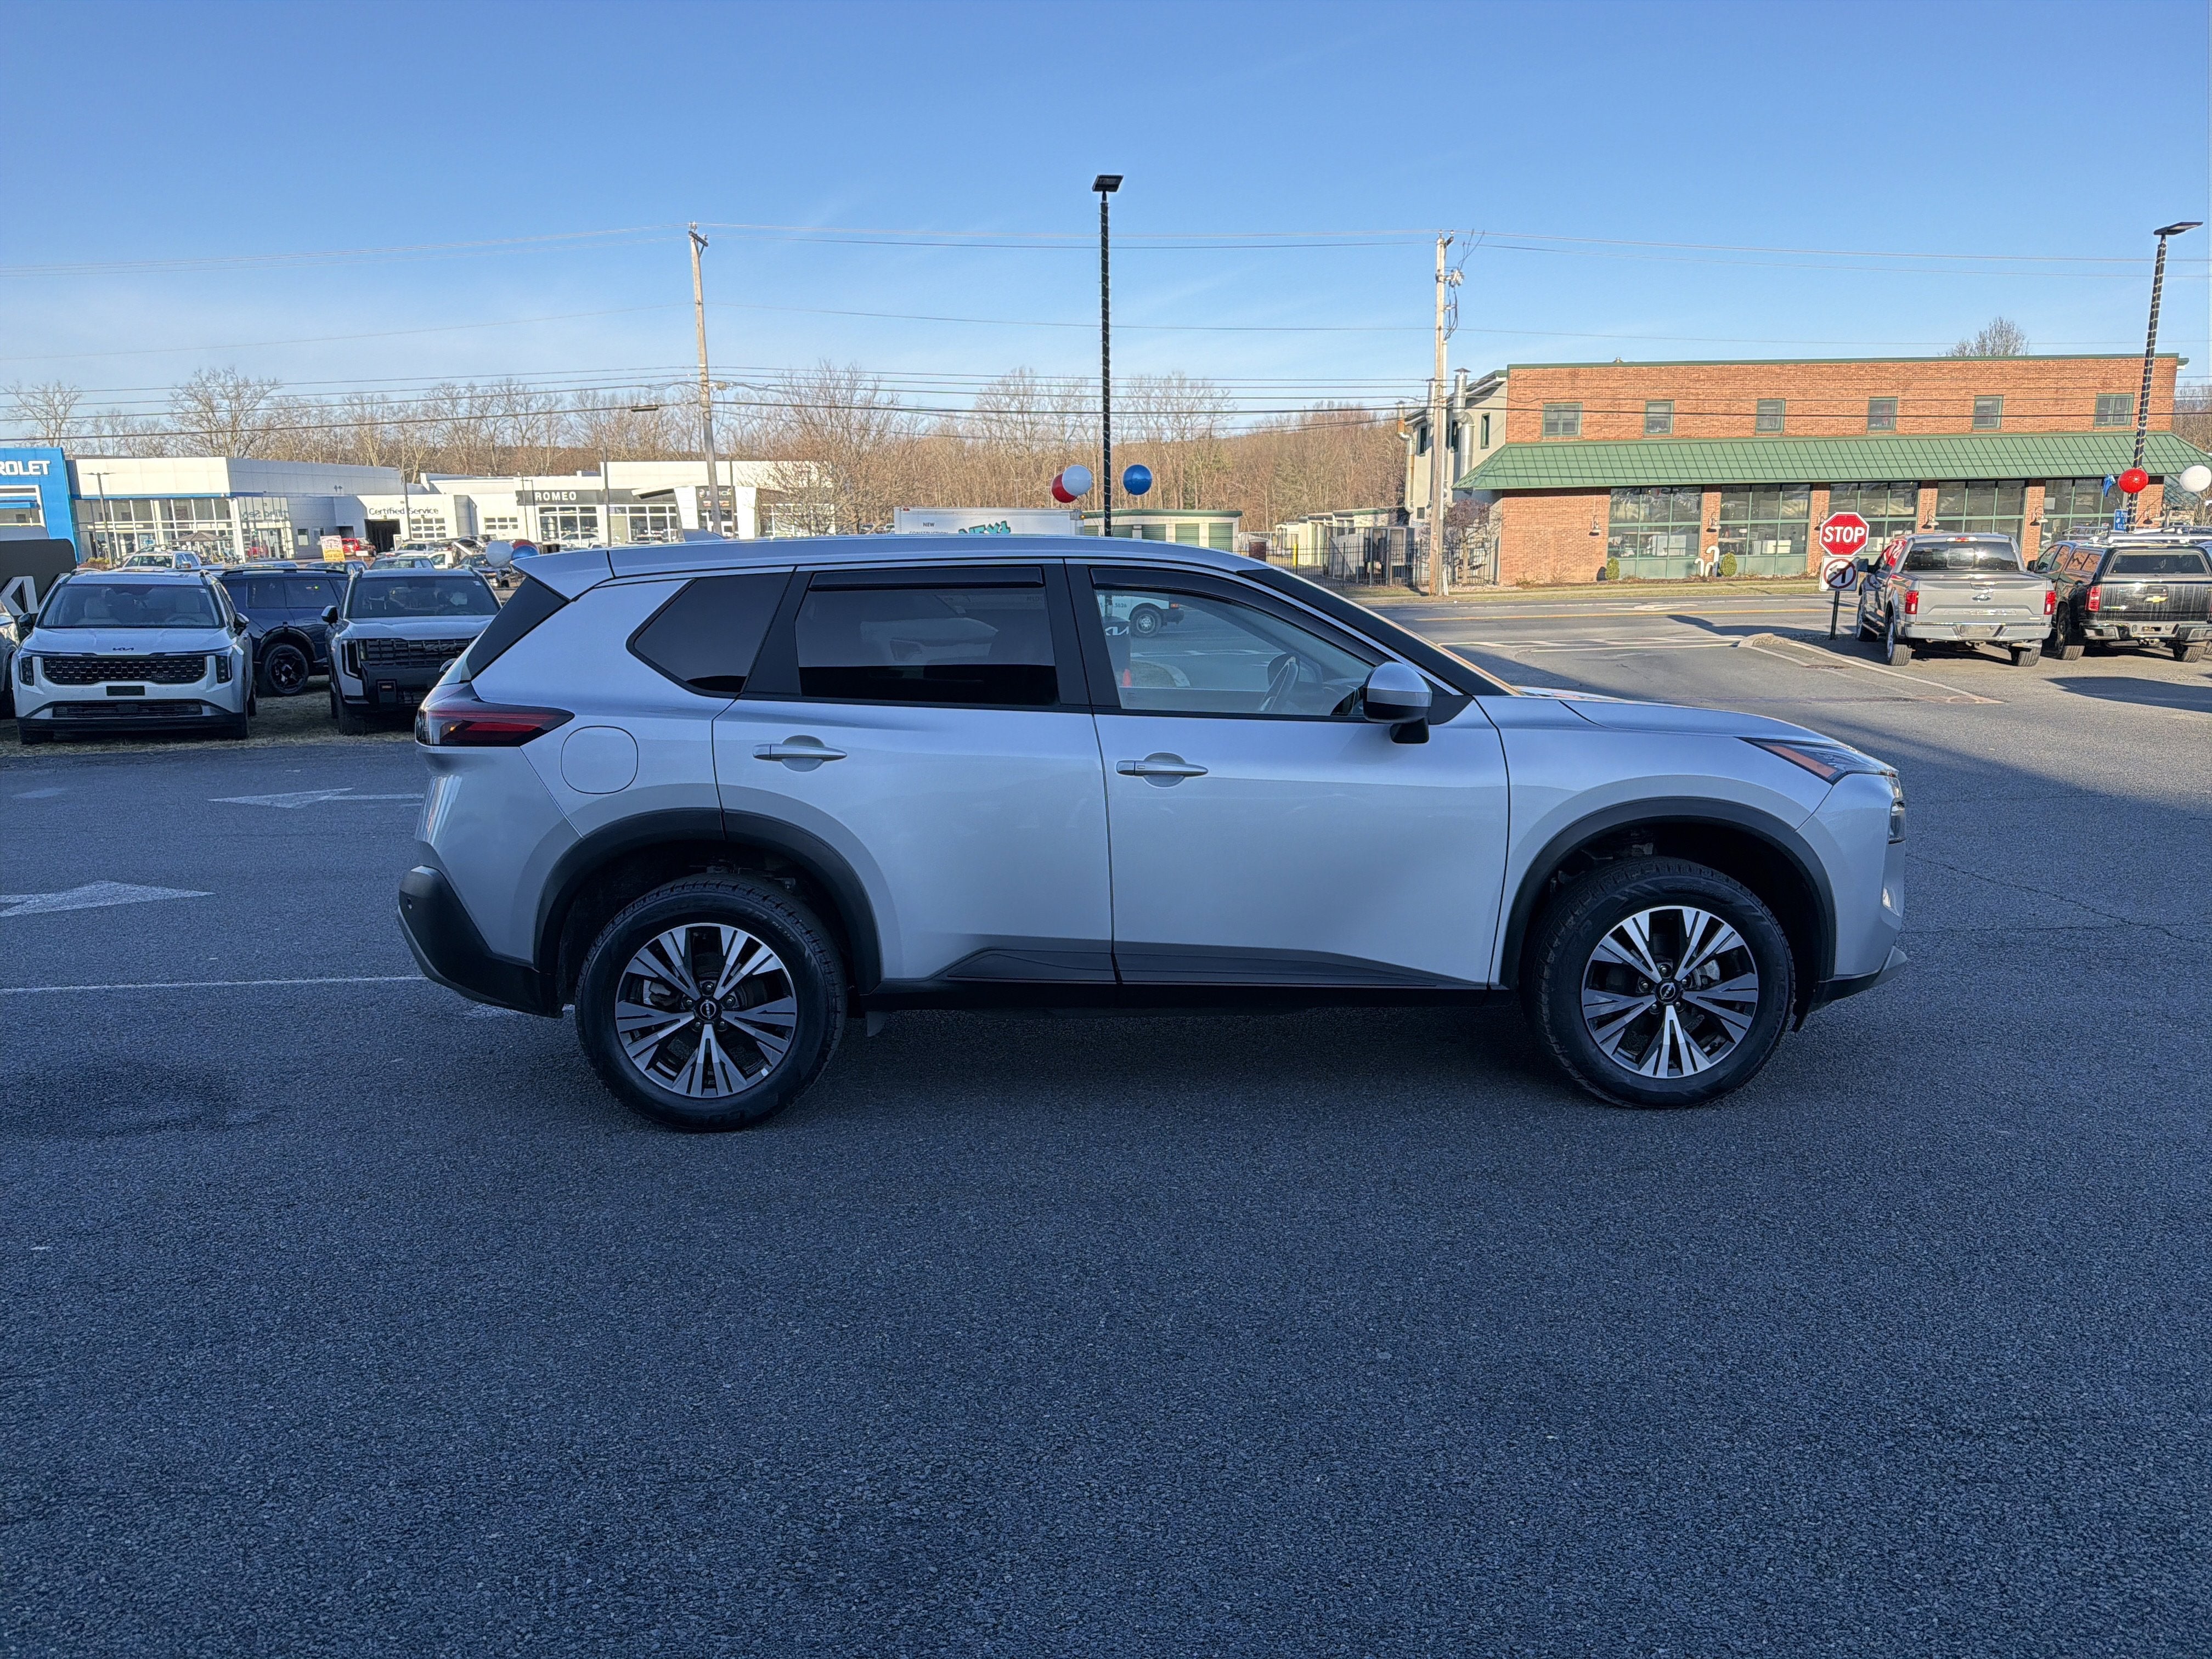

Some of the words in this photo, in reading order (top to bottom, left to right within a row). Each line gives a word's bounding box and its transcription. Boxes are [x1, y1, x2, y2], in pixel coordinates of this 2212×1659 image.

[534, 492, 577, 501] ROMEO
[369, 507, 405, 515] Certified
[1823, 526, 1865, 543] STOP
